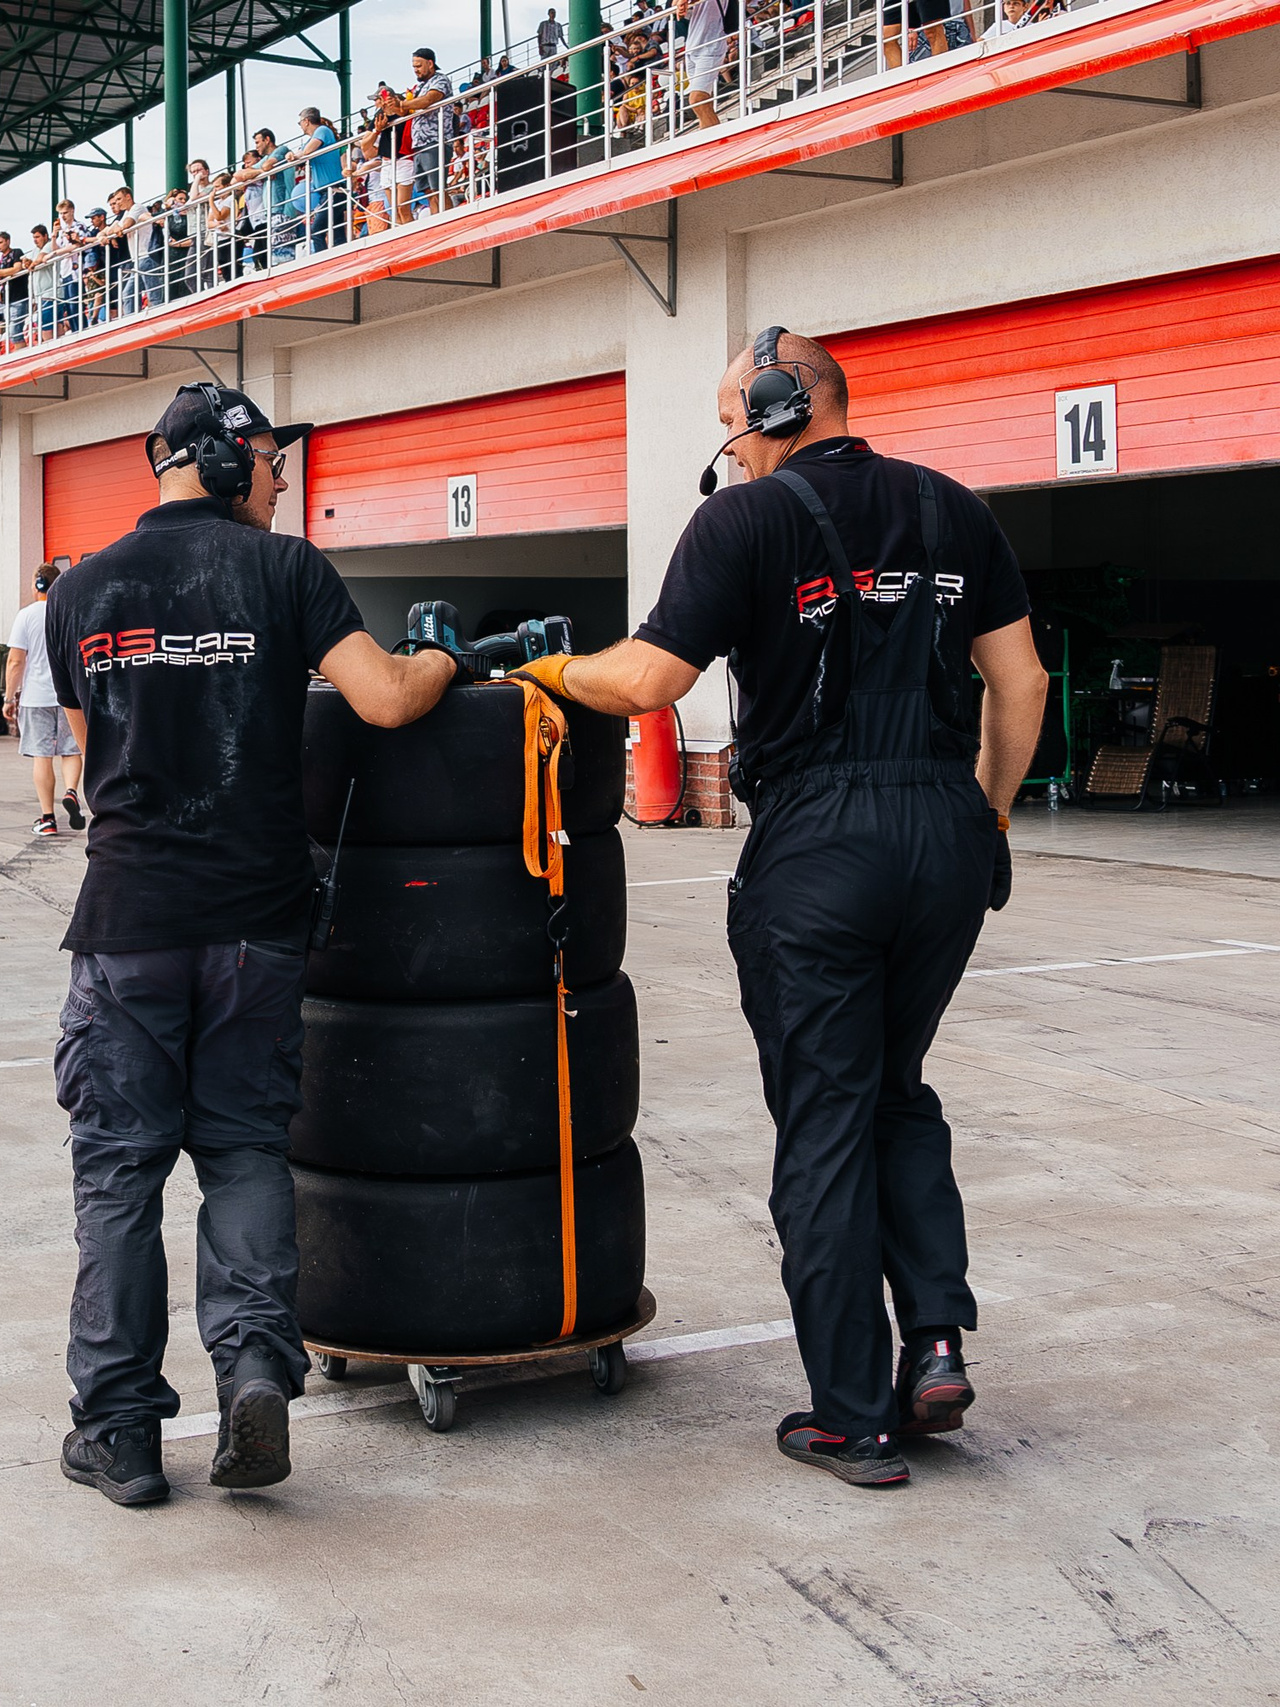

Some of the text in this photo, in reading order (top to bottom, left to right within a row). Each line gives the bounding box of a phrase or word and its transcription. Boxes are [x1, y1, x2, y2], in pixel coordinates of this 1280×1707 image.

[1064, 401, 1106, 464] 14
[452, 484, 471, 528] 13
[424, 614, 435, 641] kita
[84, 652, 256, 678] MOTORSPORT
